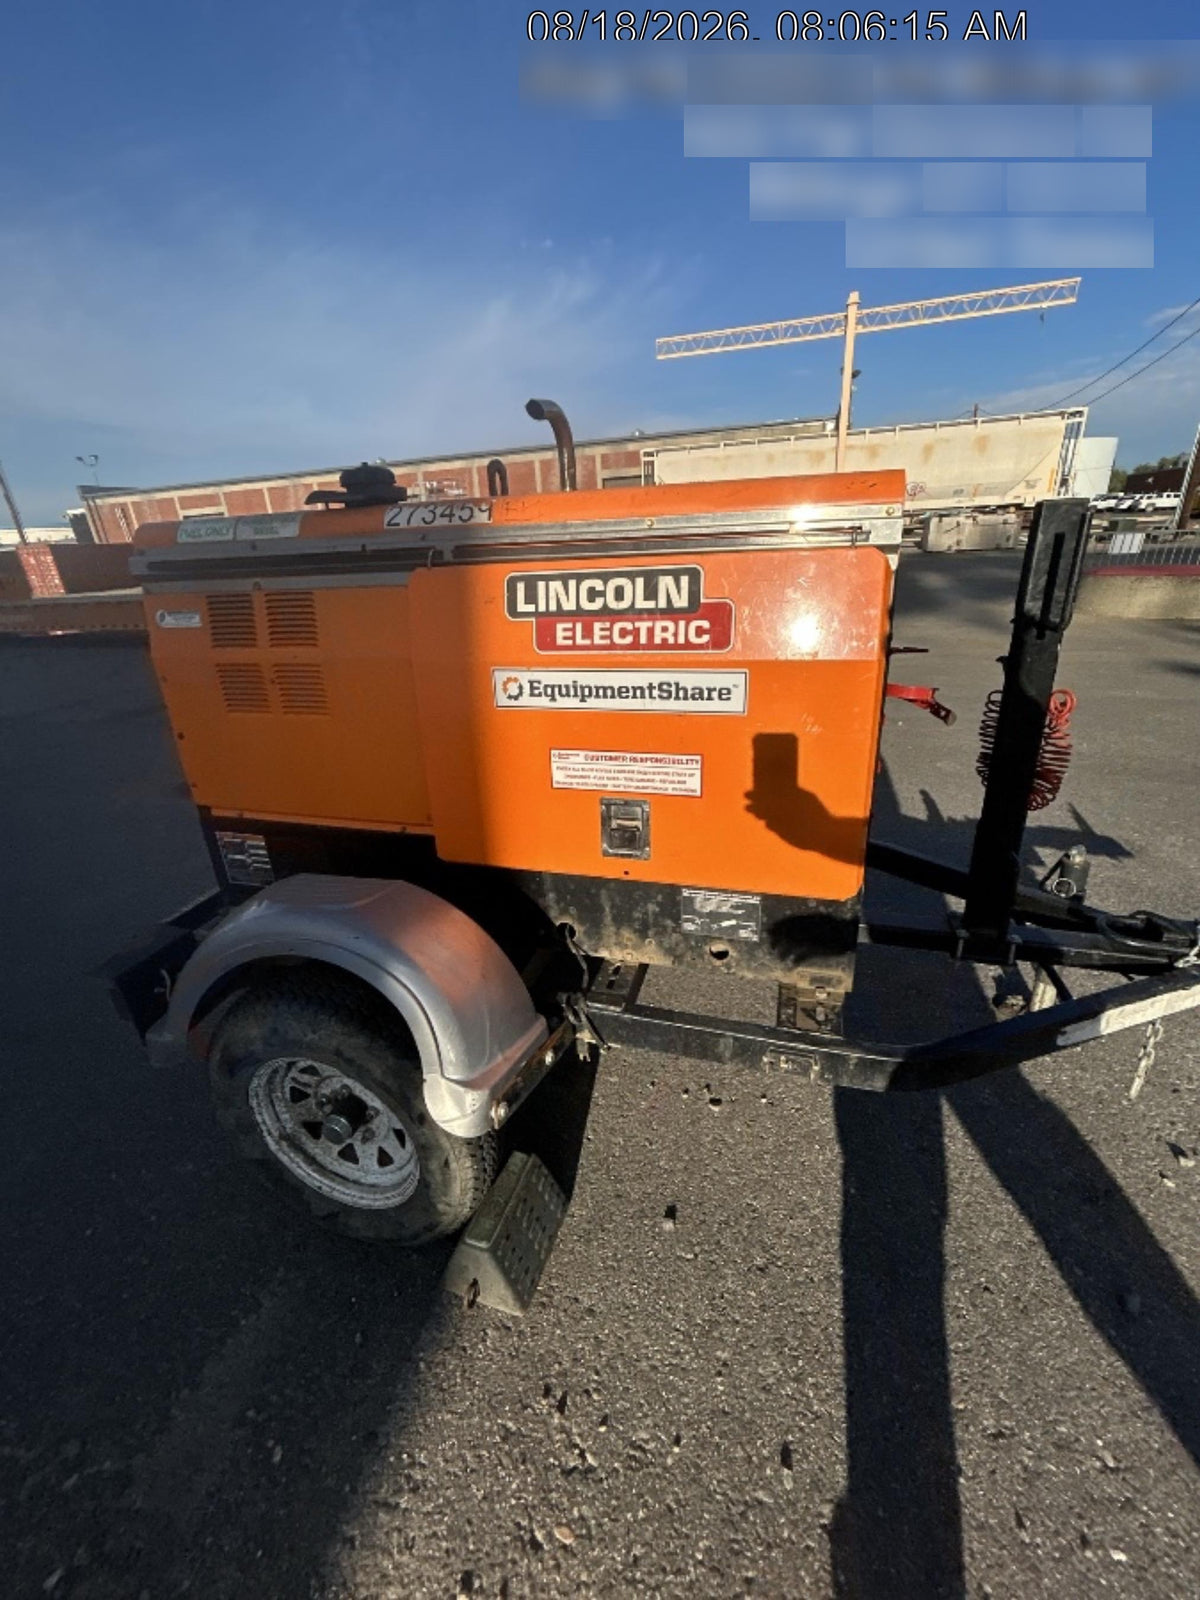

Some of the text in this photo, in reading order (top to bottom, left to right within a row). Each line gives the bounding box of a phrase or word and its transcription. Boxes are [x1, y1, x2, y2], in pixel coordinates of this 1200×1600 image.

[516, 575, 690, 612] LINCOLN
[555, 620, 711, 646] ELECTRIC
[527, 679, 732, 702] EquipmentShare
